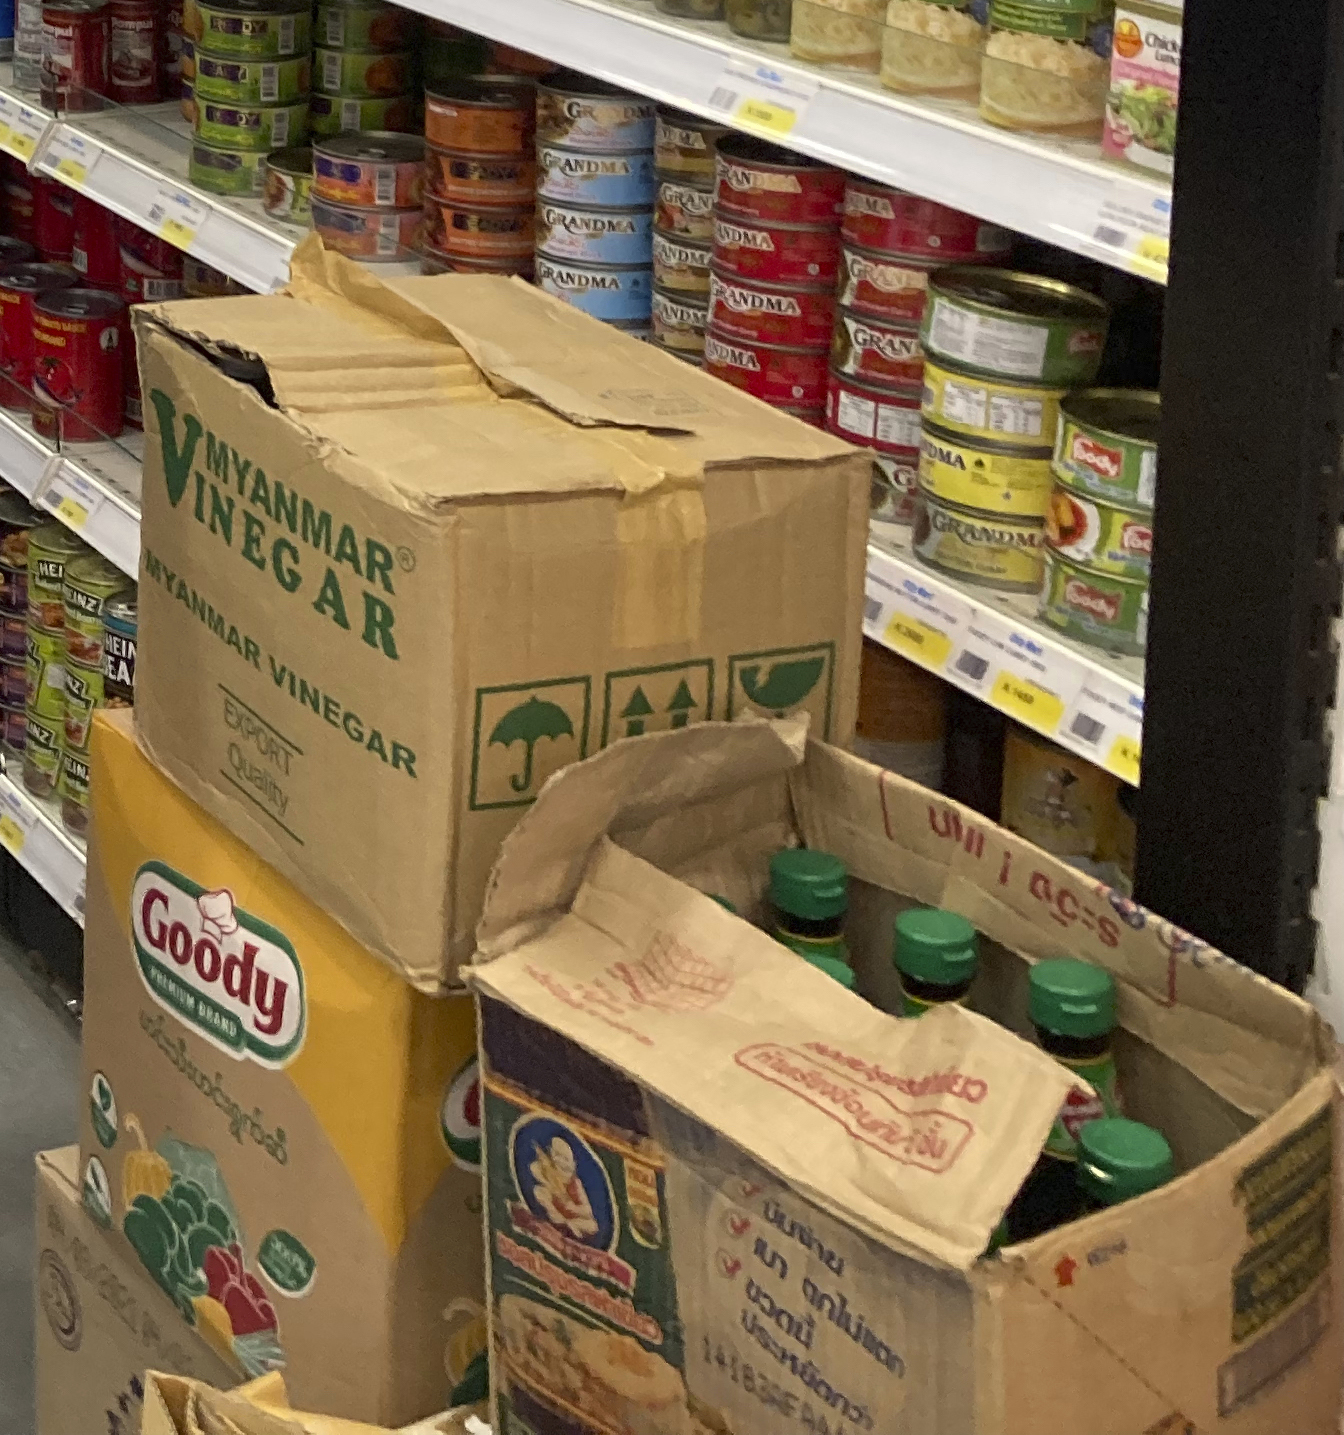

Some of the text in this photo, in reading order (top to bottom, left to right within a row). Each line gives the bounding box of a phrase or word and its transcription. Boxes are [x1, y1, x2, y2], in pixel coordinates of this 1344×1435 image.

[542, 150, 631, 177] GRANDMA
[662, 184, 712, 210] GRAN
[545, 206, 637, 236] GRANDMA
[538, 260, 621, 290] GRANDMA
[853, 328, 914, 357] GRAN
[205, 431, 398, 599] MYANMAR
[932, 515, 1043, 550] GRANDM
[39, 560, 63, 579] HEI
[105, 631, 138, 660] HEIN
[143, 547, 420, 780] MYANMAR VINEGAR
[222, 698, 296, 775] EXPORT
[226, 741, 292, 818] Quality
[139, 887, 288, 1036] Goody
[148, 965, 239, 1041] PREMIUM BRAND
